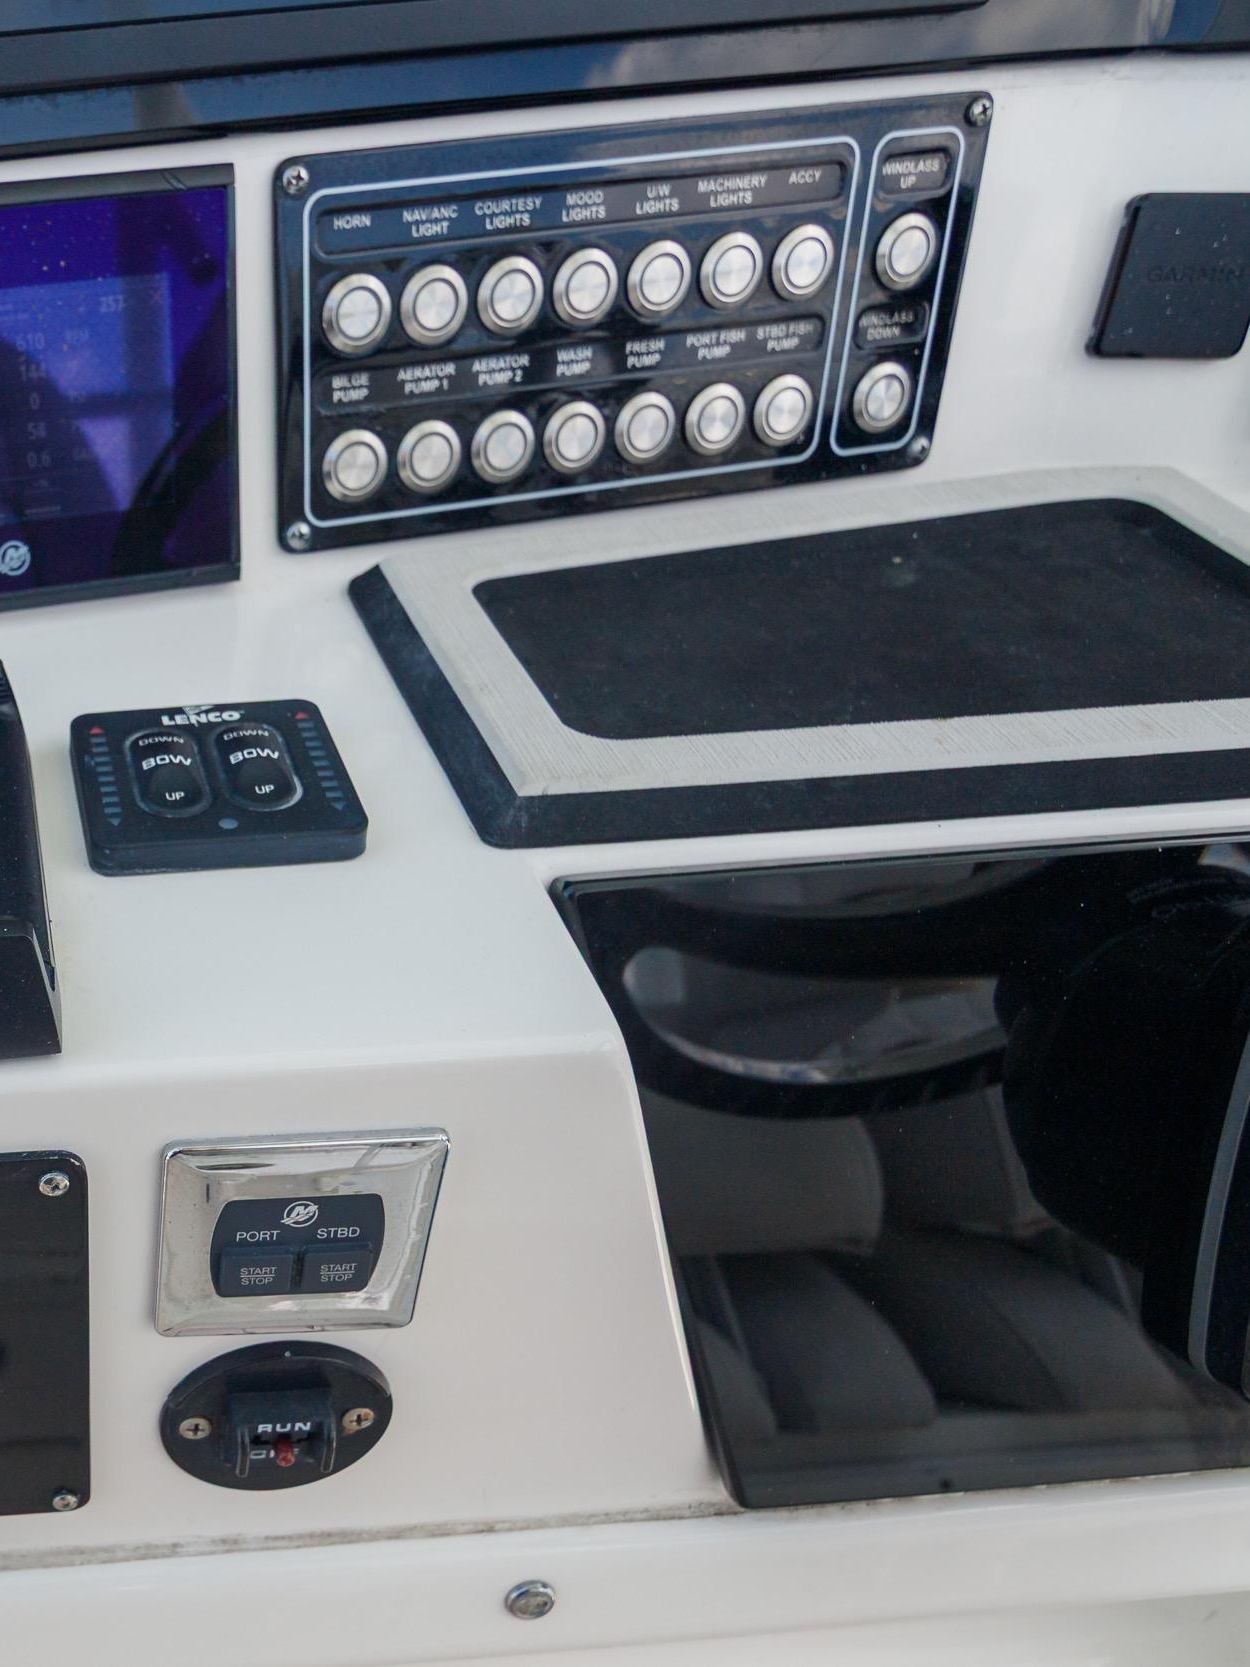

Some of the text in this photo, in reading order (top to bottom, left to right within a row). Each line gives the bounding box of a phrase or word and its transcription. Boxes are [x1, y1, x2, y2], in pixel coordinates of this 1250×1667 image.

[882, 158, 940, 176] WINDLASS
[697, 174, 768, 194] MACHINERY
[788, 168, 822, 185] ACCY
[900, 177, 917, 189] UP
[474, 197, 542, 216] COURTESY
[565, 191, 605, 206] MOOD
[635, 198, 680, 215] LIGHTS
[709, 191, 753, 208] LIGHTS
[485, 213, 531, 230] LIGHTS
[561, 205, 606, 222] LIGHTS
[333, 214, 372, 231] HORN
[411, 223, 450, 238] LIGHT
[686, 327, 747, 348] PORT FISH
[756, 323, 787, 341] STBD
[866, 326, 901, 342] DOWN
[625, 338, 666, 355] FRESH
[697, 344, 732, 361] PUMP
[766, 338, 800, 353] PUMP
[556, 346, 593, 363] WASH
[626, 353, 662, 370] PUMP
[397, 362, 456, 382] AERATOR
[471, 354, 531, 374] AERATOR
[556, 362, 592, 377] PUMP
[331, 372, 370, 389] BILGE
[478, 370, 524, 387] PUMP 2
[332, 388, 370, 404] PUMP
[404, 380, 450, 396] PUMP 1
[161, 710, 242, 727] LENCO
[138, 735, 185, 747] DOWN
[223, 728, 270, 742] DOWN
[141, 754, 192, 771] BOW
[229, 747, 280, 765] BOW
[165, 791, 186, 801] UP
[254, 784, 276, 795] UP
[236, 1229, 281, 1243] PORT
[316, 1226, 361, 1239] STBD
[239, 1266, 278, 1276] START
[319, 1262, 358, 1273] START
[240, 1277, 274, 1286] STOP
[320, 1273, 354, 1283] STOP
[257, 1421, 311, 1434] RUN
